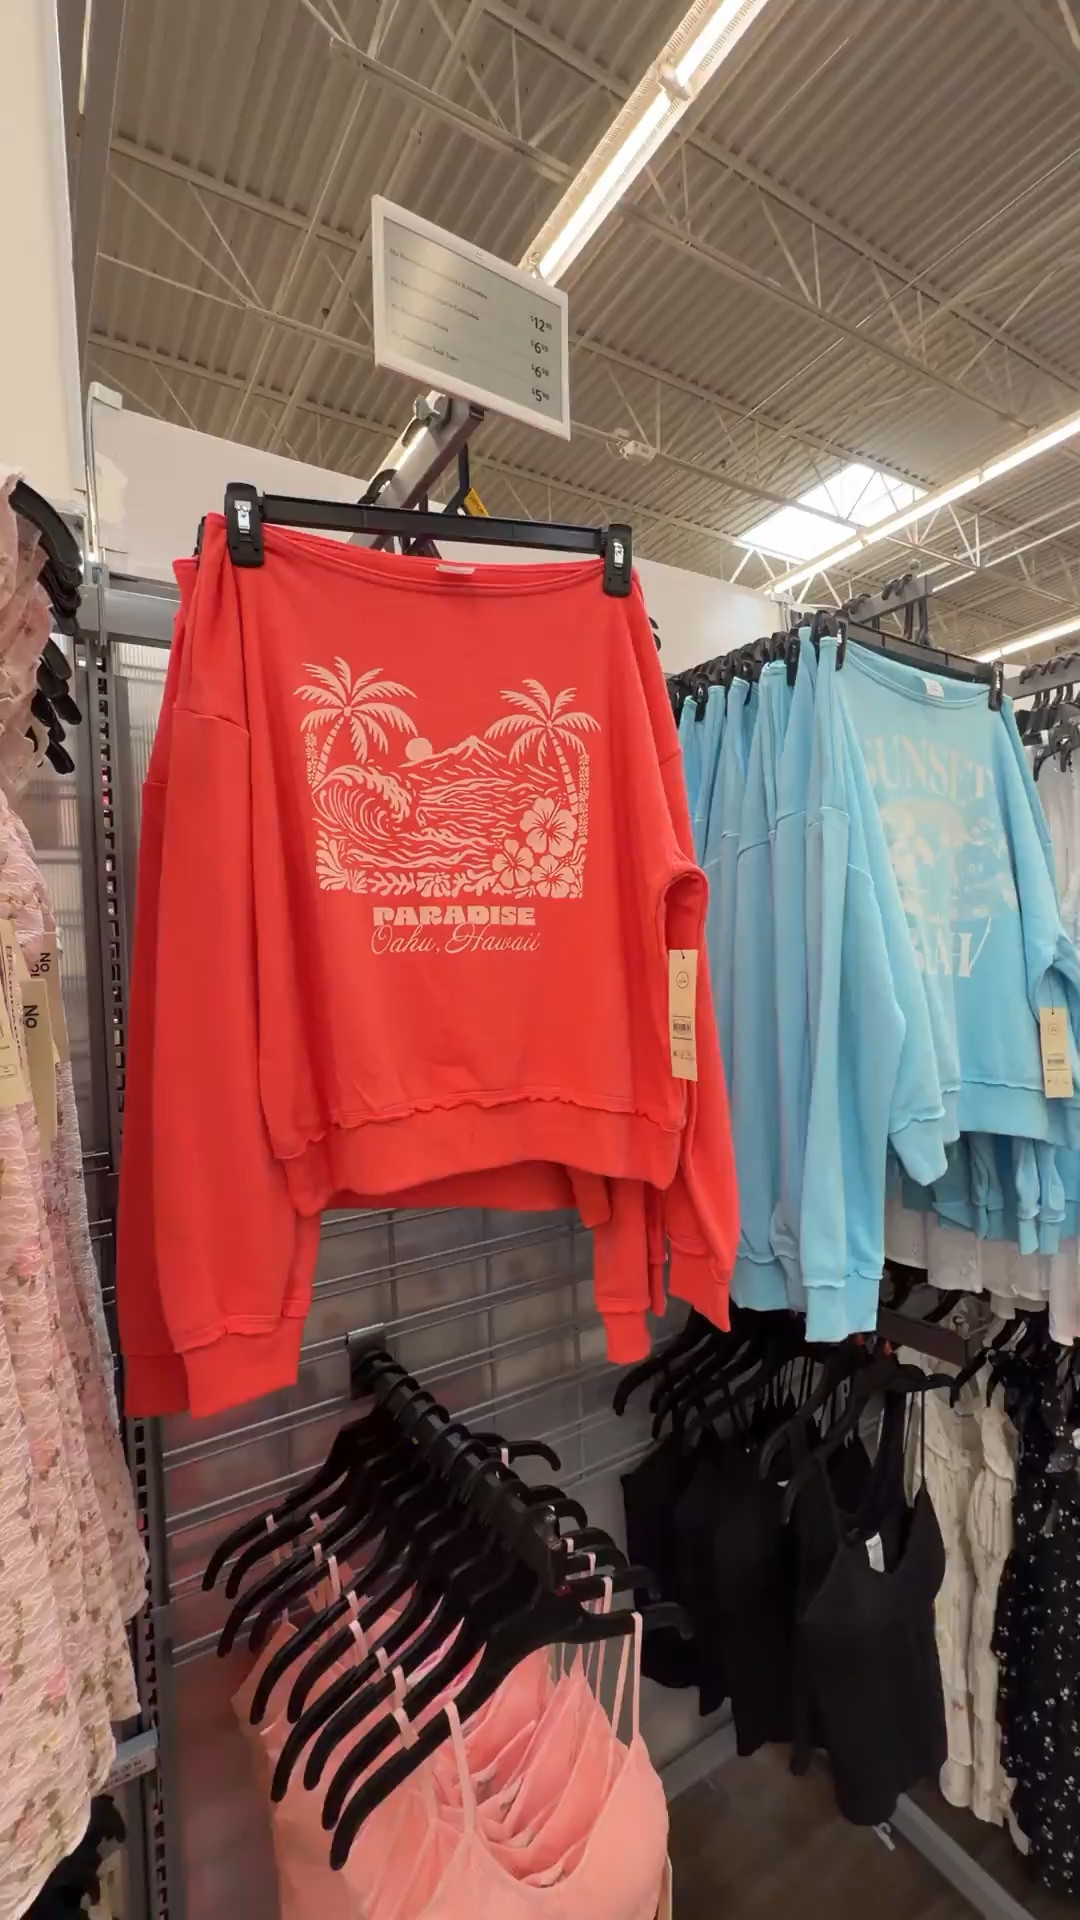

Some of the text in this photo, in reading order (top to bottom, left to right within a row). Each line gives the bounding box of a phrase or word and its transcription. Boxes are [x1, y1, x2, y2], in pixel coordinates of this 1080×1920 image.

[372, 905, 537, 927] PARADISE
[371, 921, 541, 955] Oahu, Hawaii
